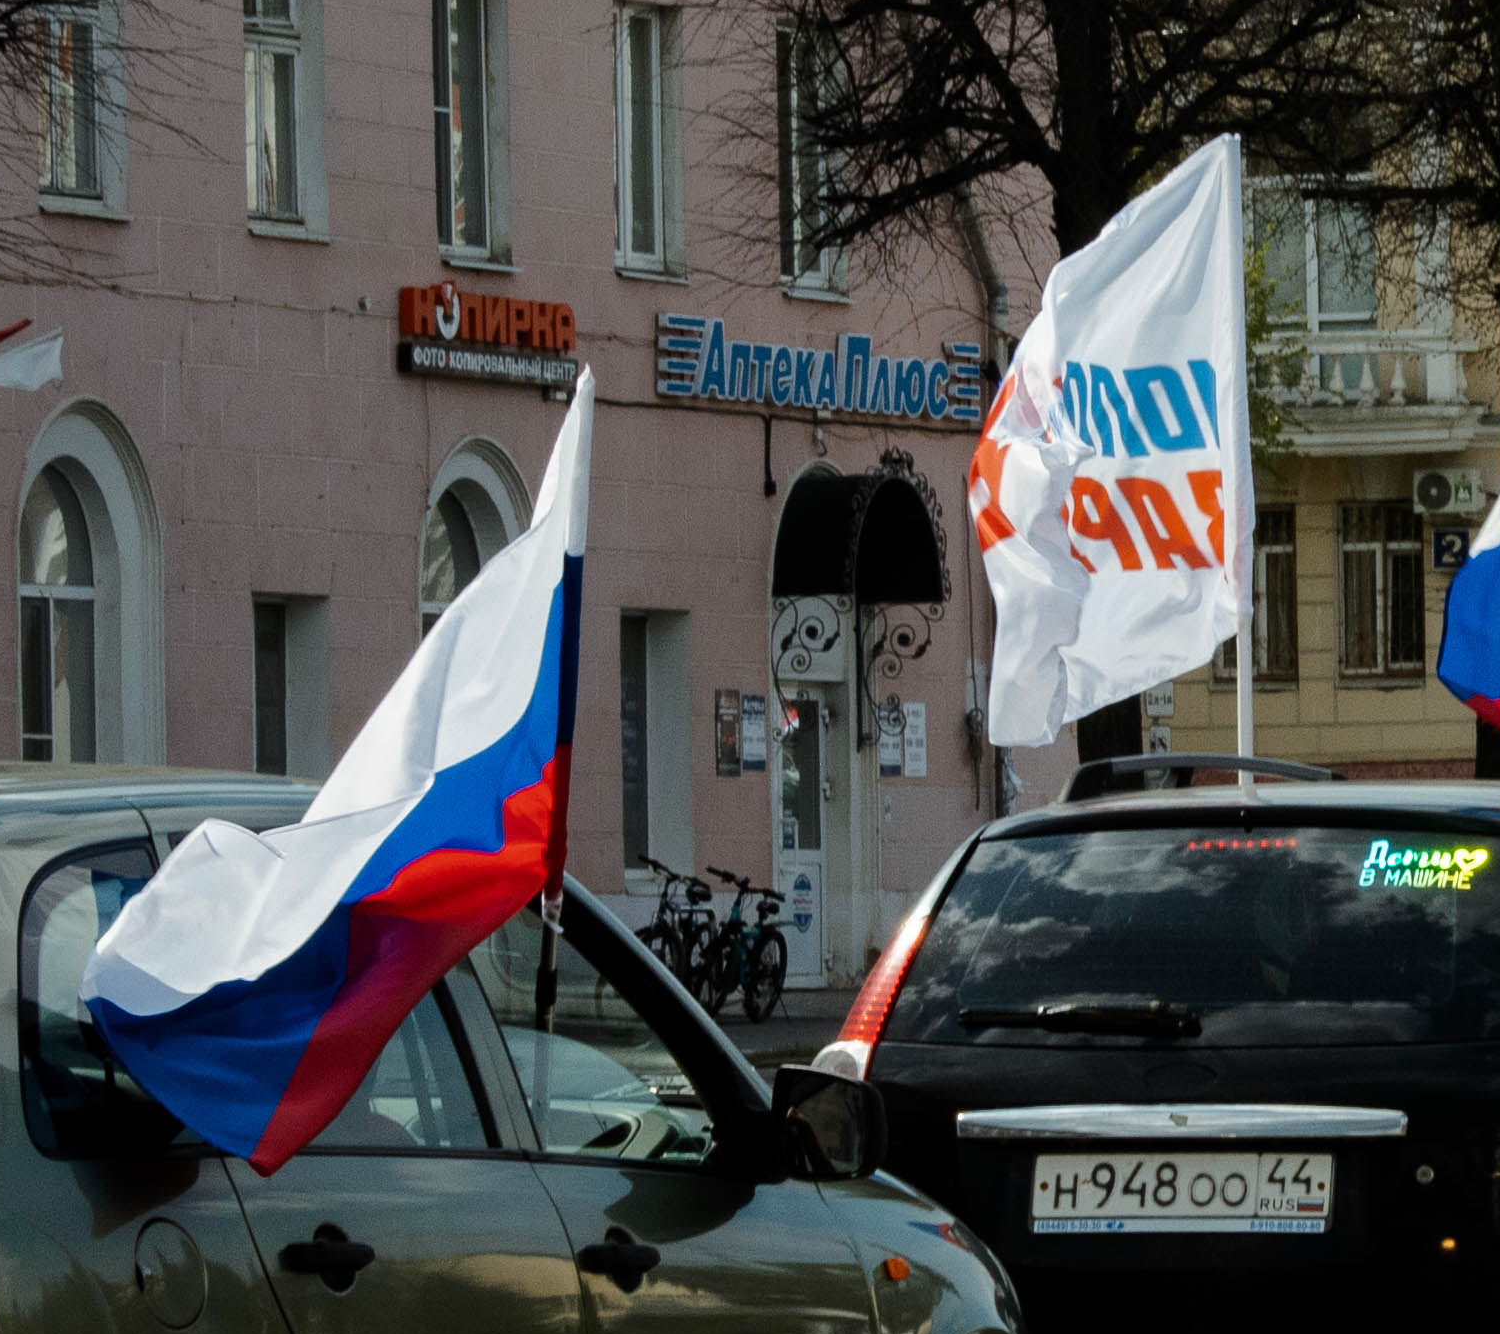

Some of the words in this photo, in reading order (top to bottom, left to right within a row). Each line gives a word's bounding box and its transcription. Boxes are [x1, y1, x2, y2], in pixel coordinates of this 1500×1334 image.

[413, 280, 576, 351] КОПИРКА
[413, 346, 445, 368] ФОТО
[448, 349, 542, 378] КОПИРОВАЛЬНЫЙ
[543, 360, 577, 382] ЦЕНТР
[841, 333, 950, 418] Плюс
[1359, 869, 1376, 887] В
[1384, 869, 1474, 890] МАШИНЕ
[1267, 1157, 1314, 1195] 44
[1259, 1197, 1296, 1212] RUS
